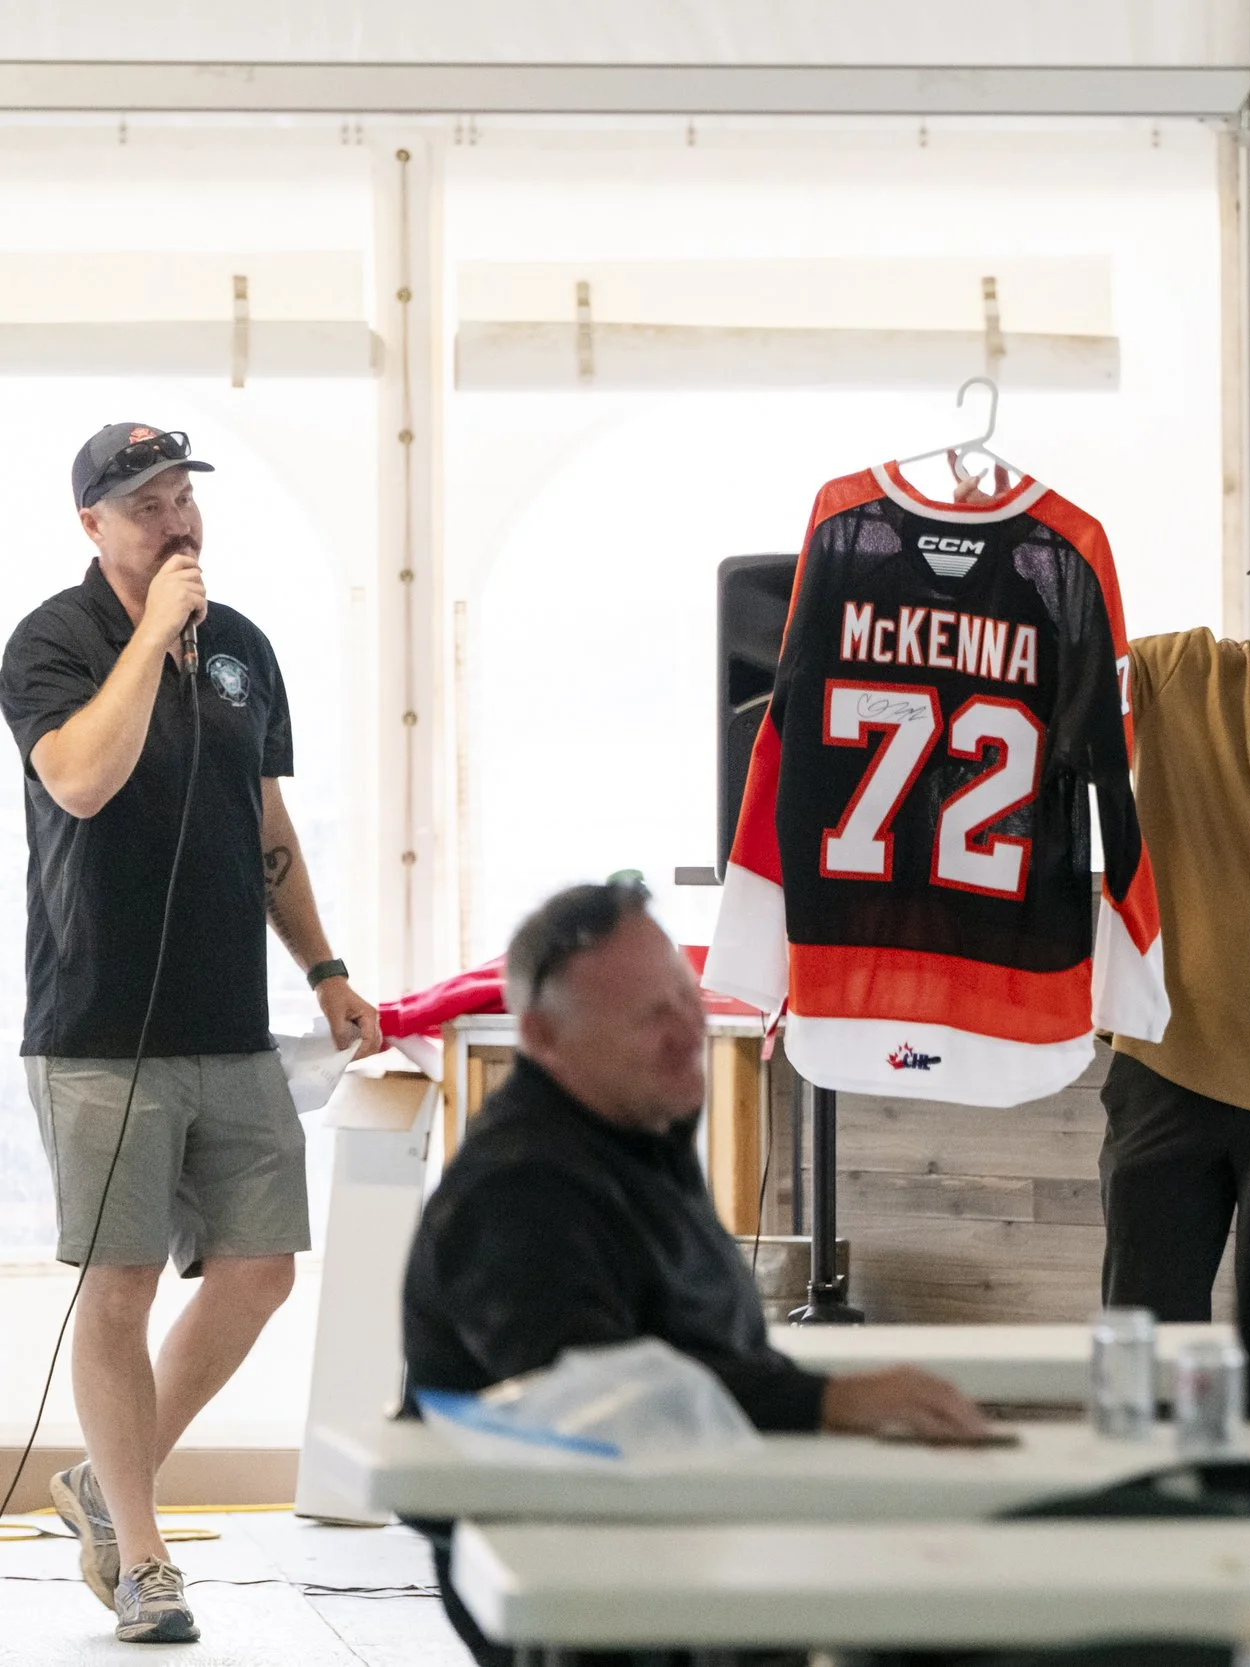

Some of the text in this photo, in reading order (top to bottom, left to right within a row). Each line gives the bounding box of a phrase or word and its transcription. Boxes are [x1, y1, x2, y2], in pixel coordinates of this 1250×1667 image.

[917, 536, 985, 555] CCM
[839, 601, 1038, 686] McKENNA
[820, 678, 1044, 901] 72
